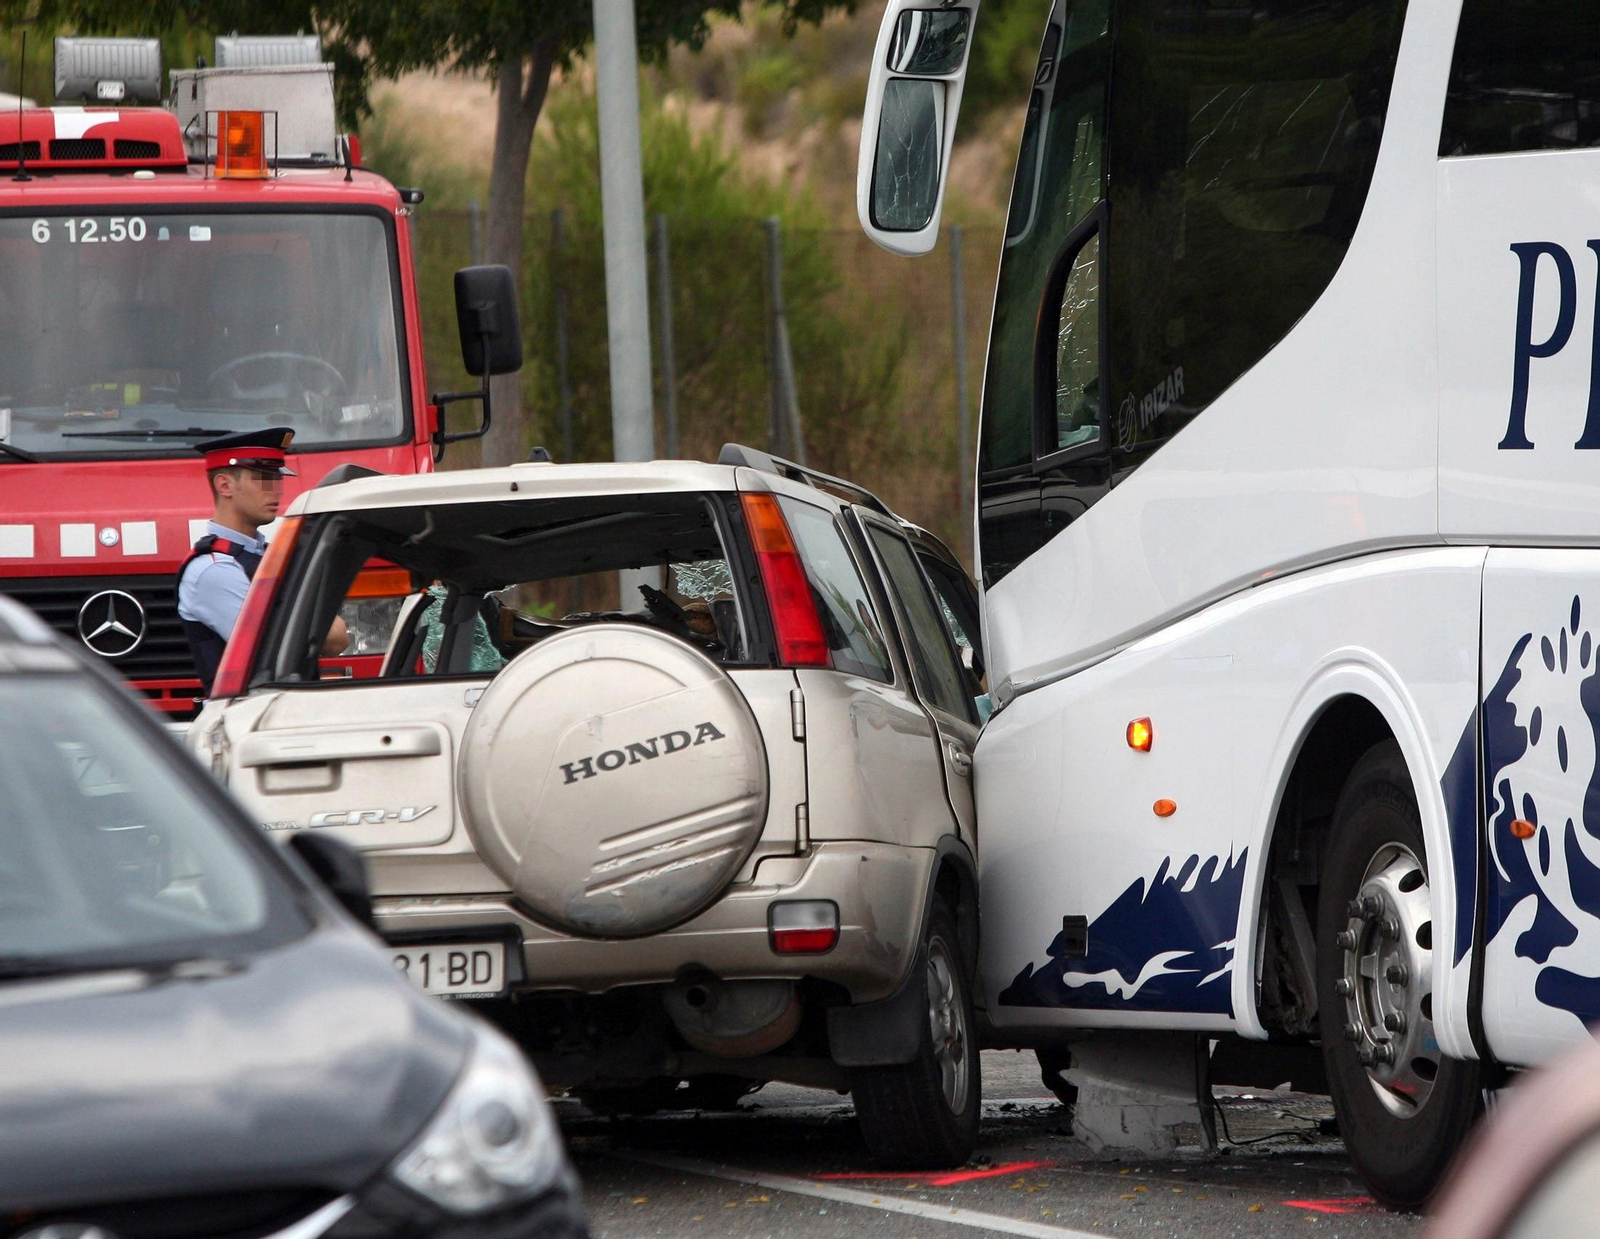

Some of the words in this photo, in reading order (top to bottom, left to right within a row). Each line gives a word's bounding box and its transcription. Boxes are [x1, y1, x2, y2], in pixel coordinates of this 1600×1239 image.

[31, 219, 50, 243] 6
[64, 217, 147, 243] 12.50
[1498, 240, 1600, 450] P
[1140, 366, 1184, 430] IRIZAR
[559, 721, 726, 785] HONDA
[262, 821, 301, 831] NDA
[309, 805, 437, 828] CR-V
